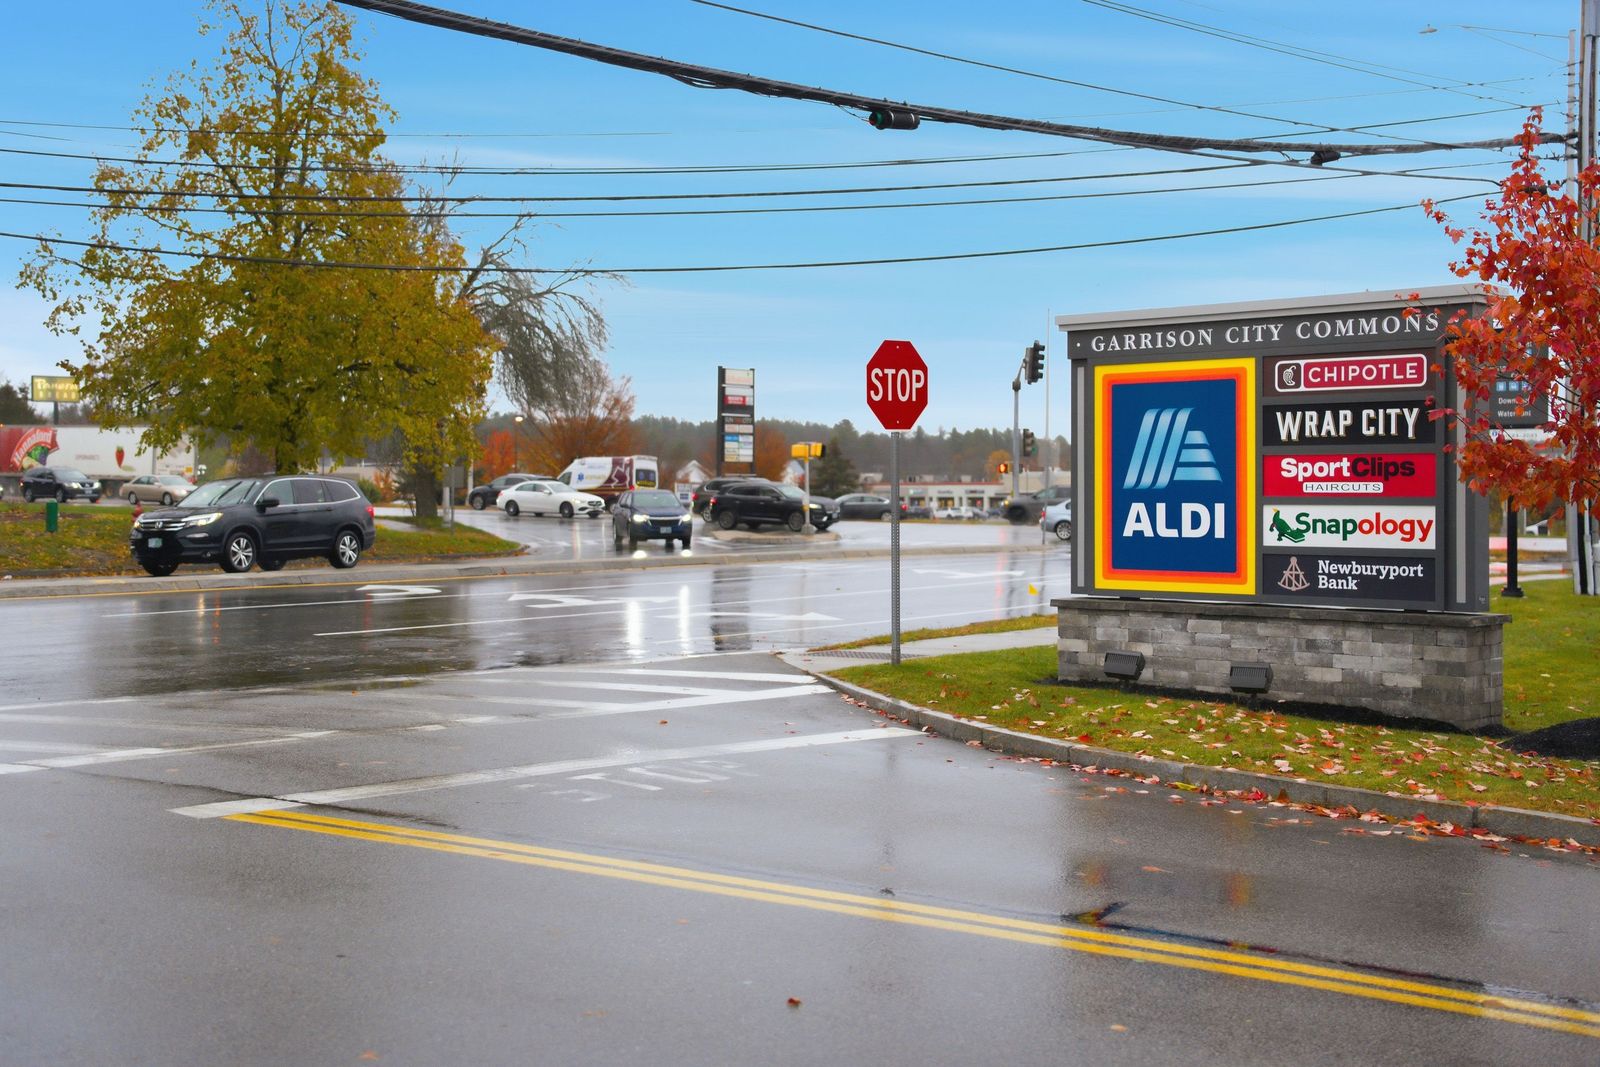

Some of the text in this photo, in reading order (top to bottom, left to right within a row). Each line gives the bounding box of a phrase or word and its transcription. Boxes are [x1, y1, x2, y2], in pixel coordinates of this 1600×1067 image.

[1091, 312, 1439, 352] GARRISON CITY COMMONS
[869, 367, 925, 402] STOP
[1308, 361, 1418, 383] CHIPOTLE
[1275, 407, 1420, 442] WRAP CITY
[1280, 457, 1415, 482] SportClips
[1304, 483, 1383, 493] HAIRCUTS
[1122, 502, 1225, 538] ALDI
[1295, 512, 1434, 543] Snapology
[1317, 559, 1424, 579] Newburyport
[1317, 576, 1359, 591] Bank
